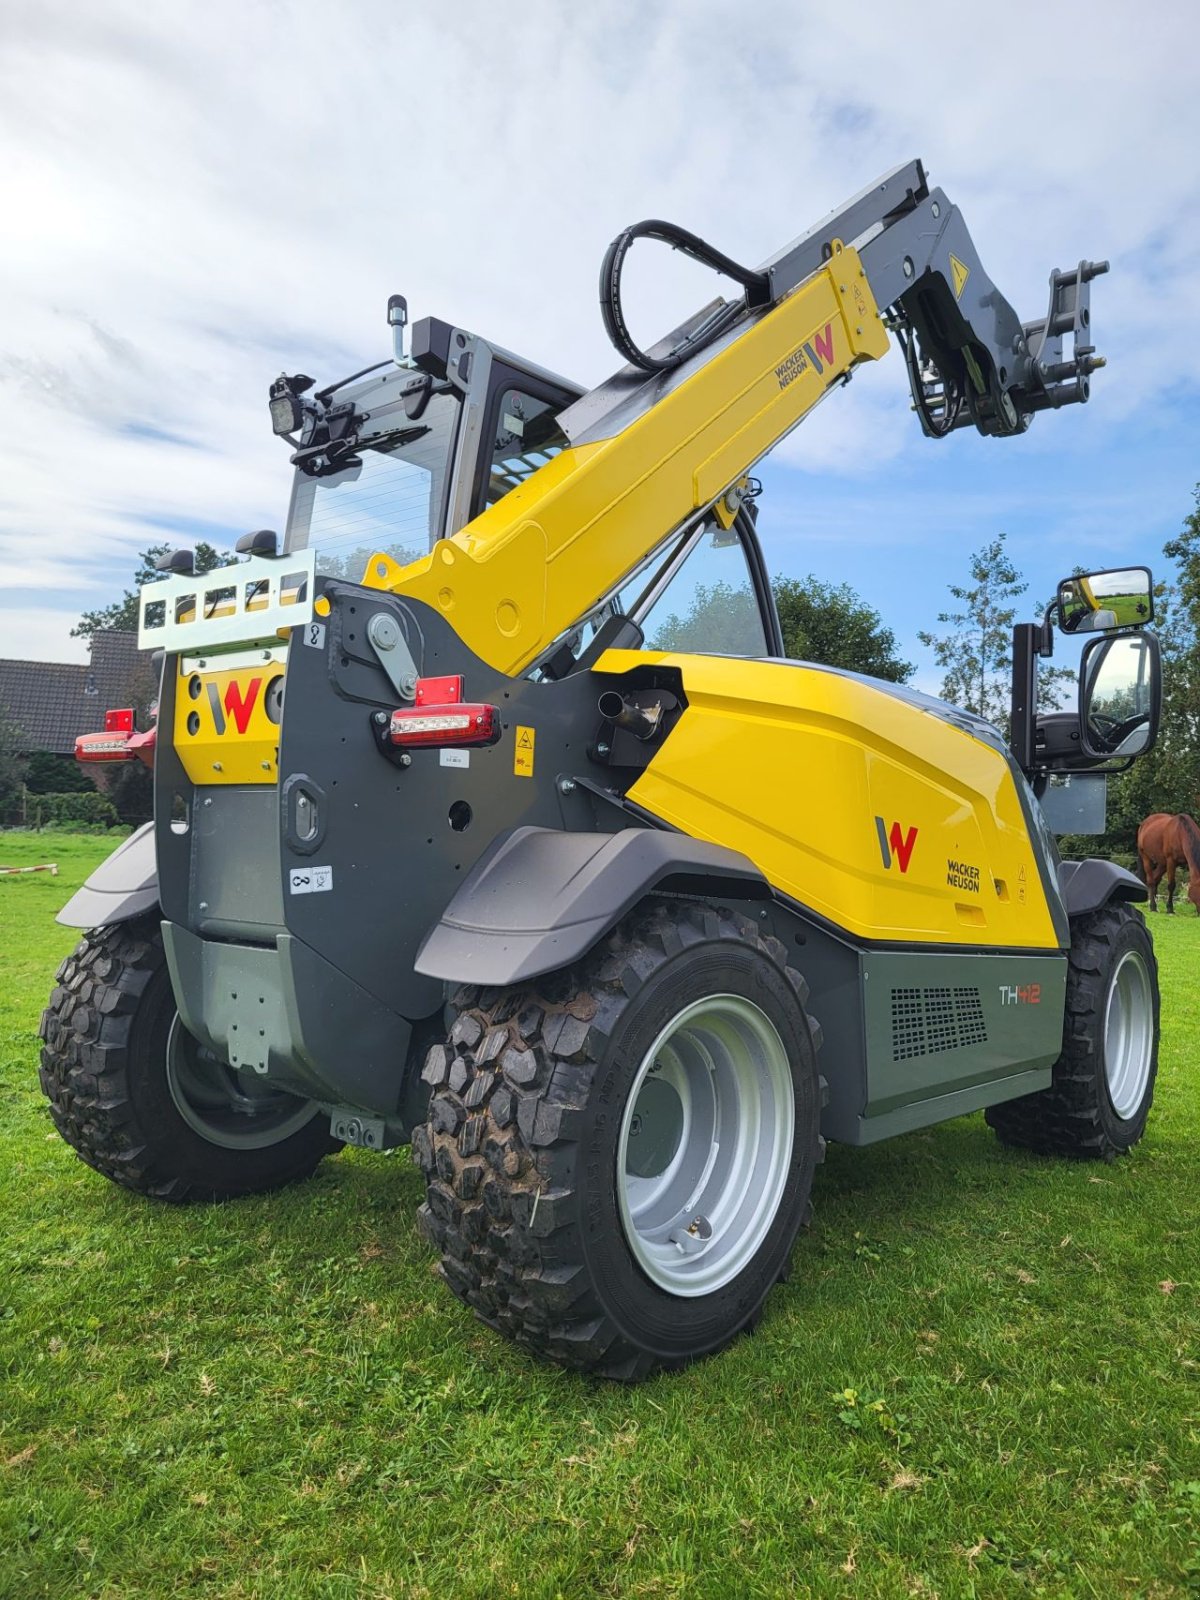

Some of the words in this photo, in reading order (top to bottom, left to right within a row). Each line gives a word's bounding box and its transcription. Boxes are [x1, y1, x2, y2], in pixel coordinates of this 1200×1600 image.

[775, 349, 805, 378] WACKER
[779, 359, 808, 390] NEUSON
[947, 859, 980, 880] WACKER
[947, 873, 980, 893] NEUSON
